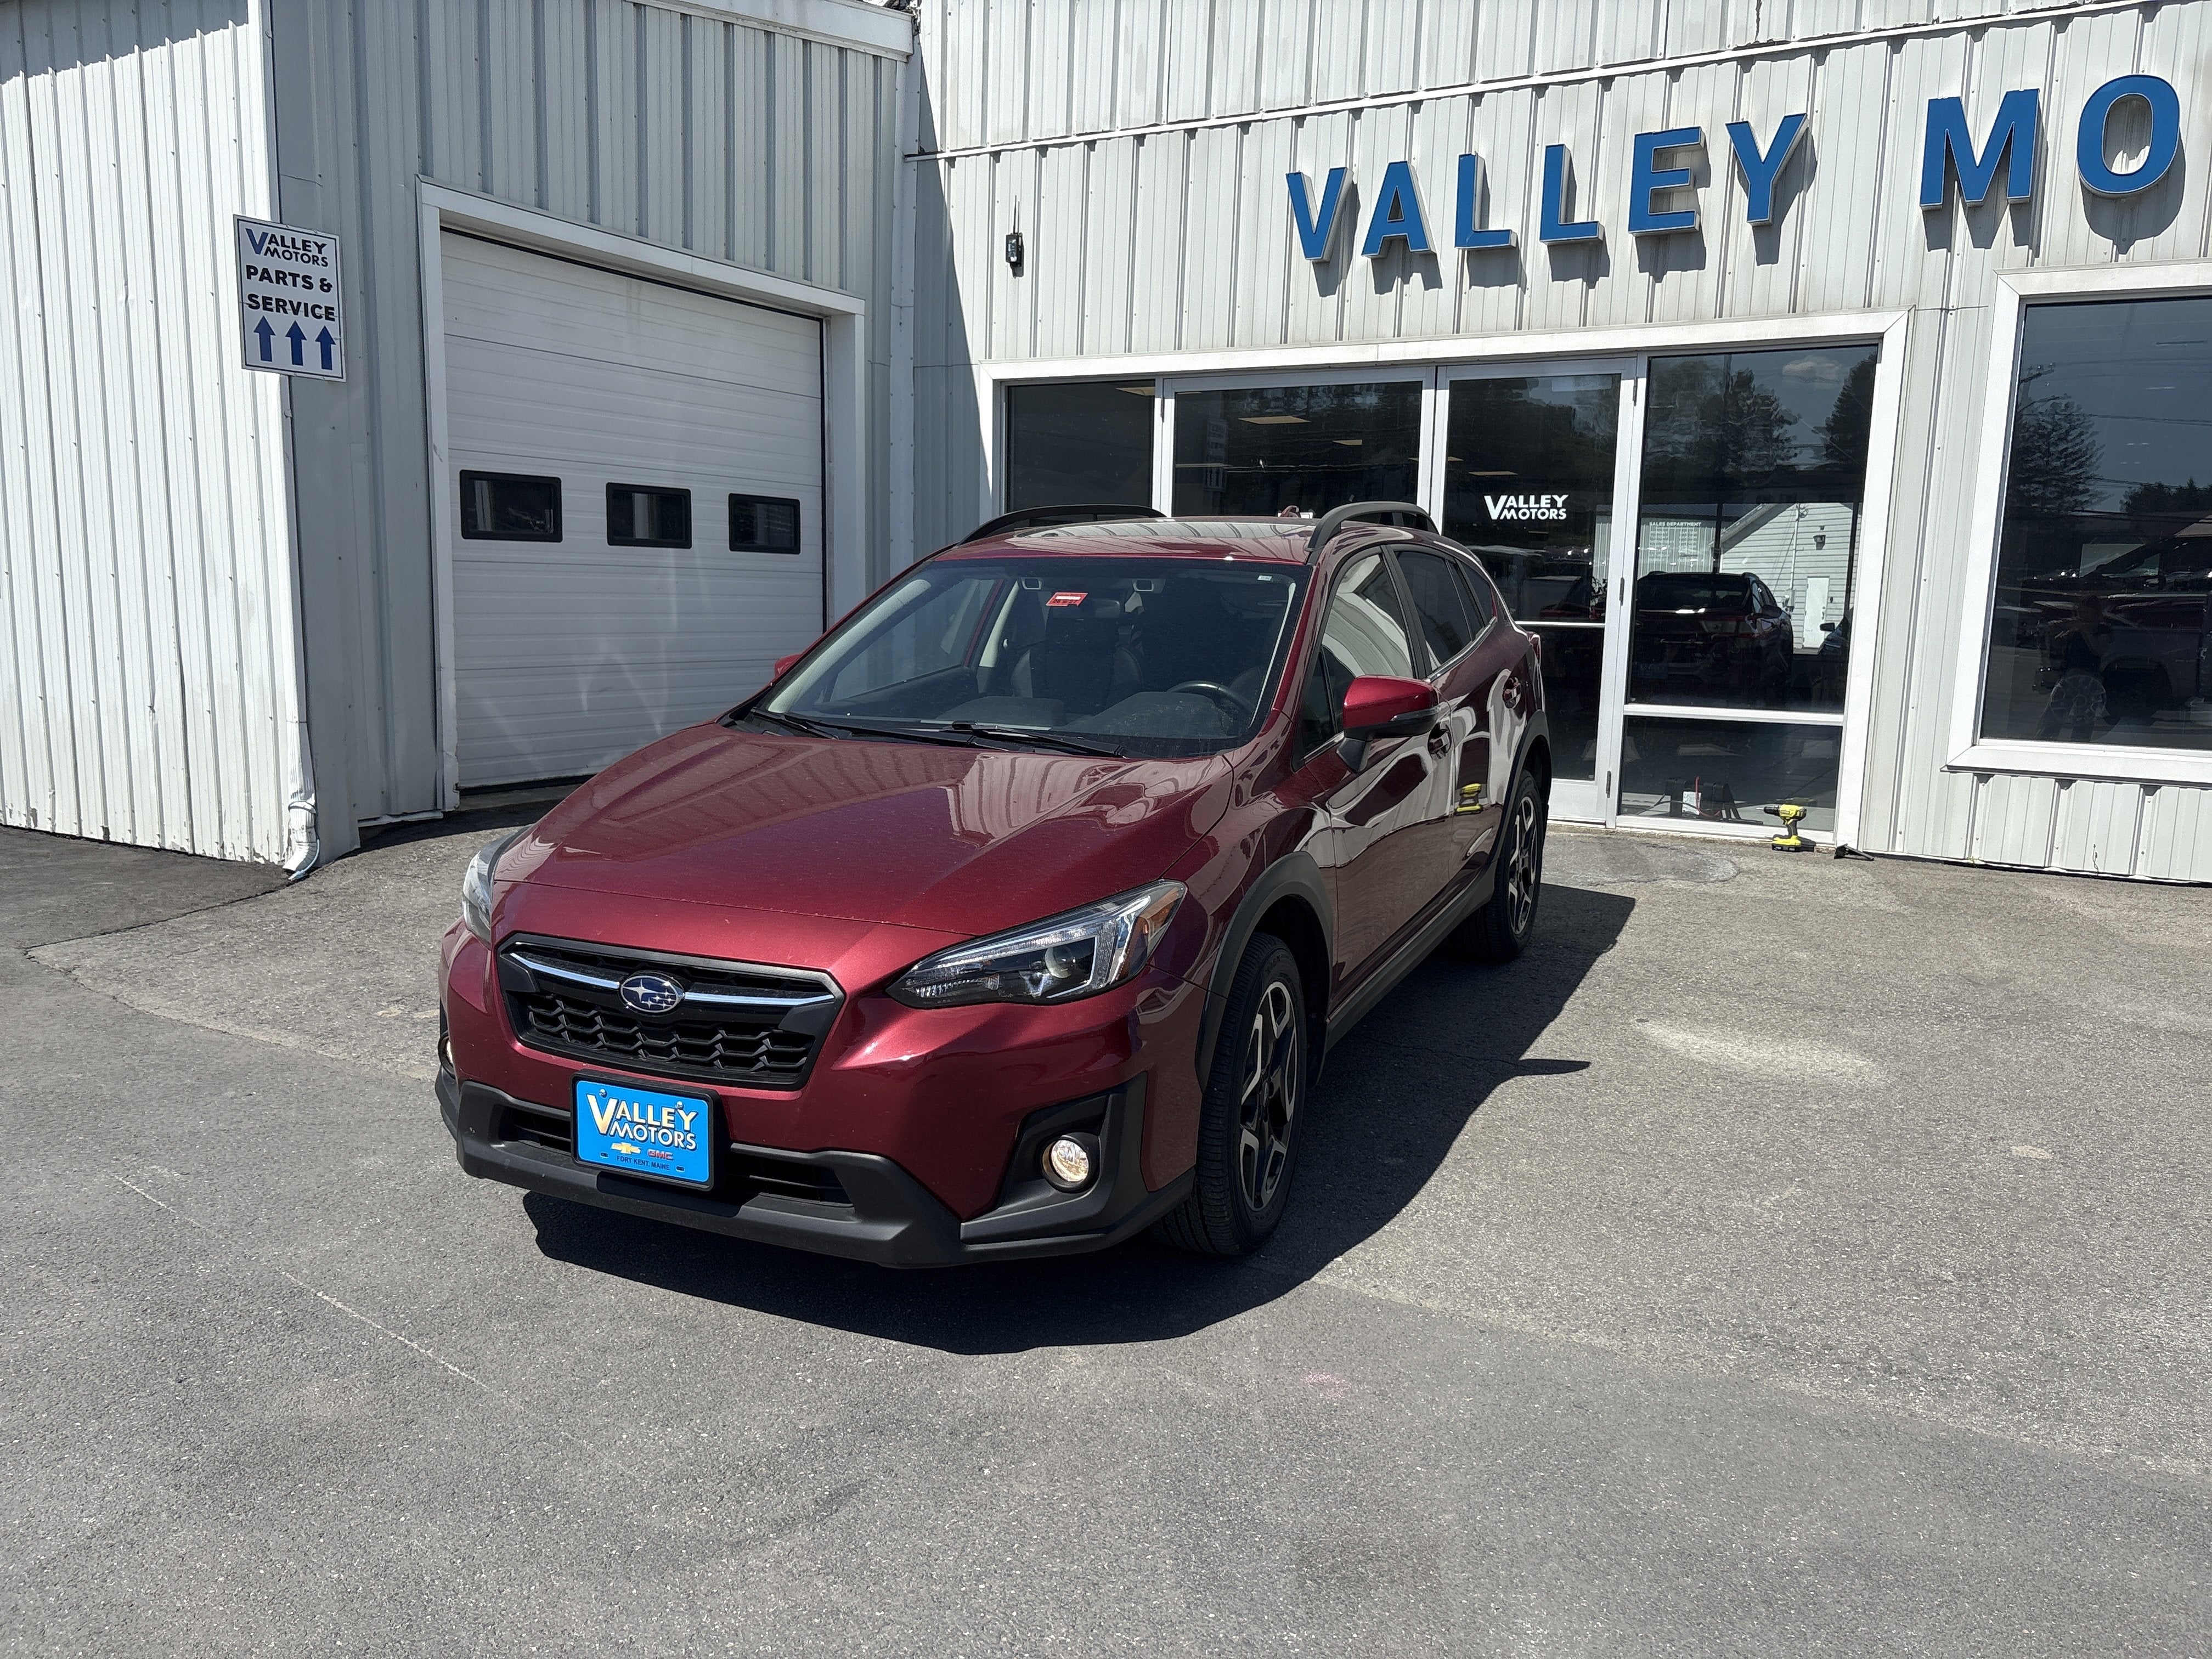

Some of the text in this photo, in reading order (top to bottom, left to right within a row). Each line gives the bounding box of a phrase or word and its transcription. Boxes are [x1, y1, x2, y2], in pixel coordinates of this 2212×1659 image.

[1286, 74, 2180, 263] VALLEY MO
[245, 228, 328, 255] VALLEY
[263, 246, 329, 267] MOTORS
[245, 264, 333, 293] PARTS &
[247, 293, 336, 321] SERVICE
[1483, 494, 1569, 520] VALLEY
[1499, 509, 1567, 520] MOTORS
[586, 1093, 699, 1135] VALLEY
[610, 1121, 697, 1150] MOTORS
[616, 1155, 670, 1171] FORT KENT, MAINE
[647, 1148, 674, 1161] GMC
